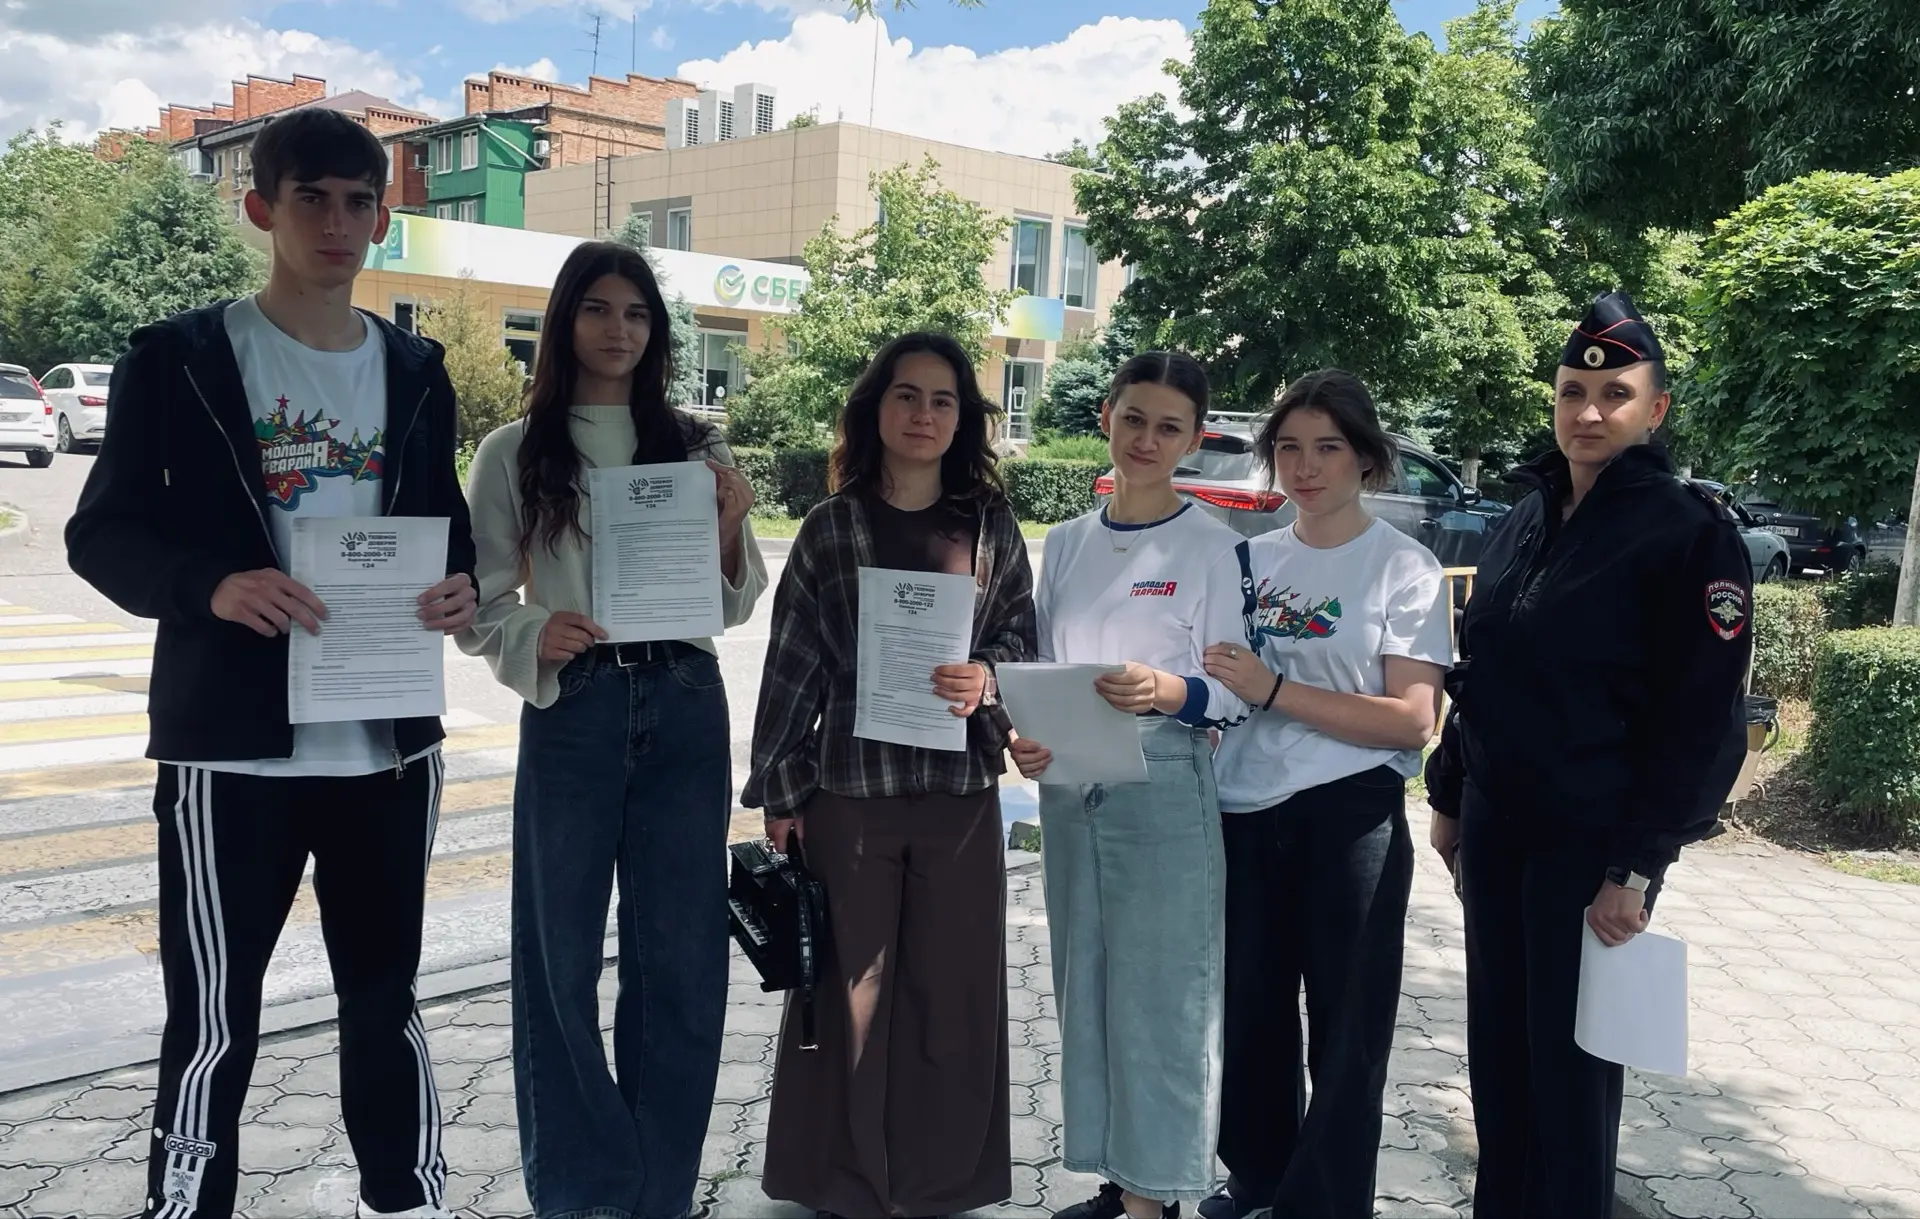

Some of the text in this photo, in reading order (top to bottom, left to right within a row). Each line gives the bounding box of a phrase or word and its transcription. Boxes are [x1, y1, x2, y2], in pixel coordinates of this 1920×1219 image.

[753, 275, 810, 301] СБЕ
[1711, 591, 1743, 606] РОССИЯ
[169, 1140, 210, 1155] adidas
